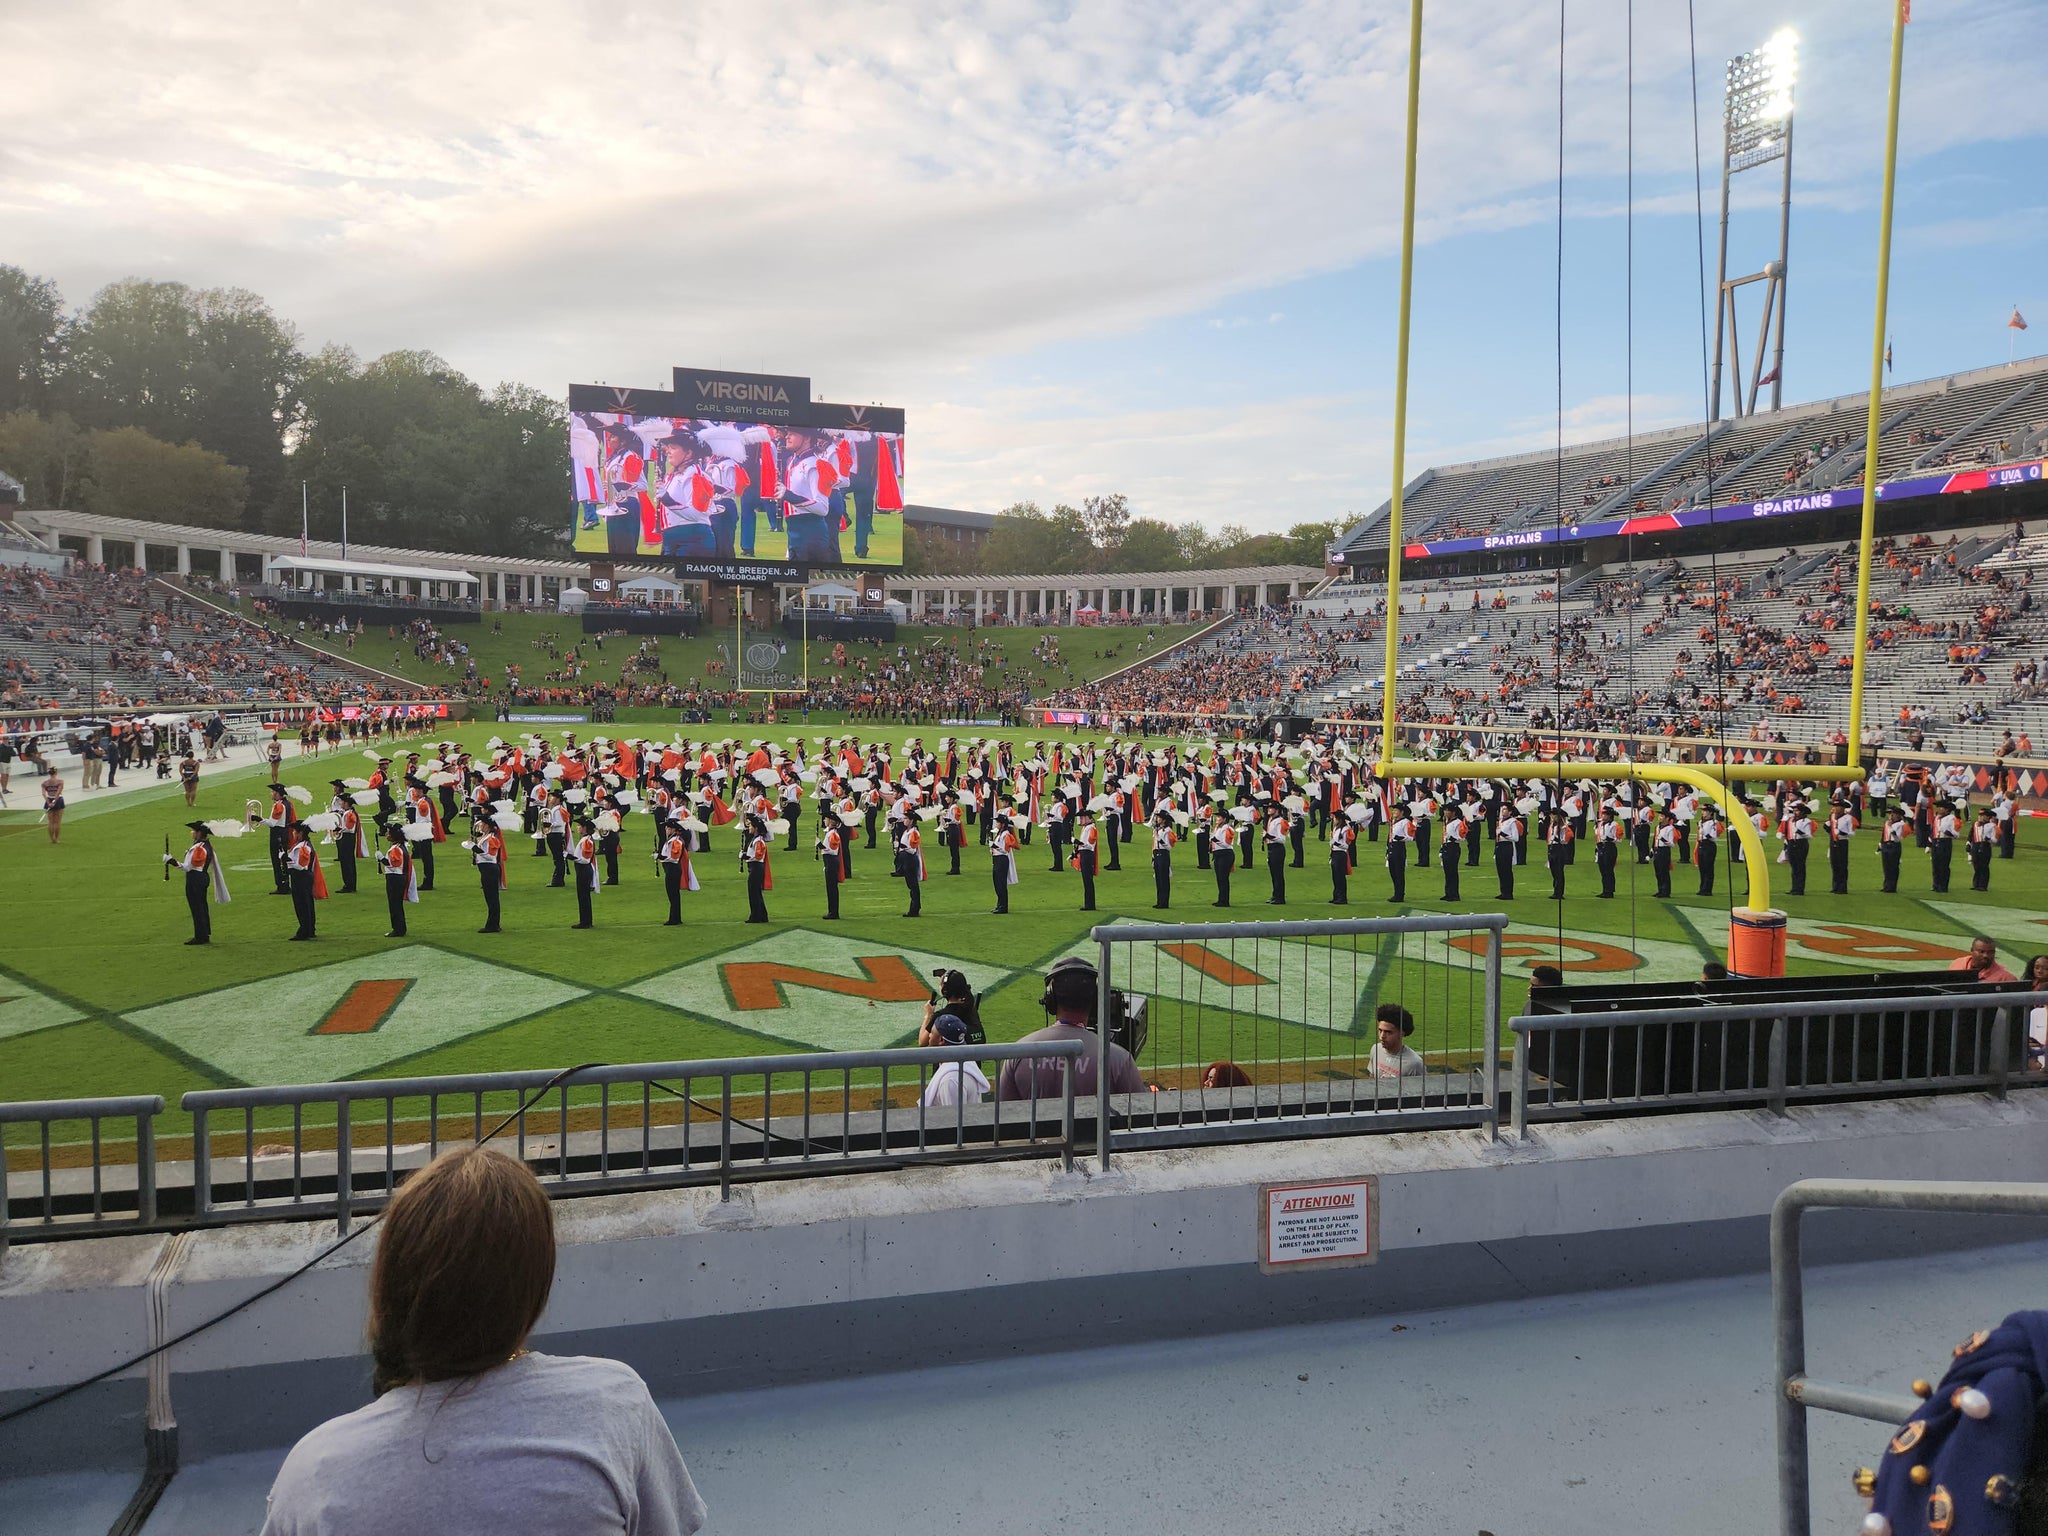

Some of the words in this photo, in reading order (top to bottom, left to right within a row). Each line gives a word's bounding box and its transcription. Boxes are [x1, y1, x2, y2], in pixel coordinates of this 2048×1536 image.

[696, 381, 790, 403] VIRGINIA
[696, 403, 721, 412] CARL
[725, 406, 752, 414] SMITH
[756, 408, 790, 416] CENTER
[2000, 469, 2021, 481] UVA
[2030, 466, 2039, 478] 0
[1753, 494, 1832, 516] SPARTANS
[1484, 532, 1542, 548] SPARTANS
[686, 564, 723, 573] RAMON
[784, 568, 798, 576] JR.
[718, 573, 766, 581] VIDEOBOARD
[595, 580, 608, 590] 40
[868, 590, 880, 600] 40
[740, 670, 787, 685] Allstate
[1283, 1194, 1355, 1210] ATTENTION!
[1278, 1218, 1304, 1226] PATRONS
[1278, 1233, 1310, 1241] VIOLATORS
[1316, 1237, 1358, 1246] PROSECUTION.
